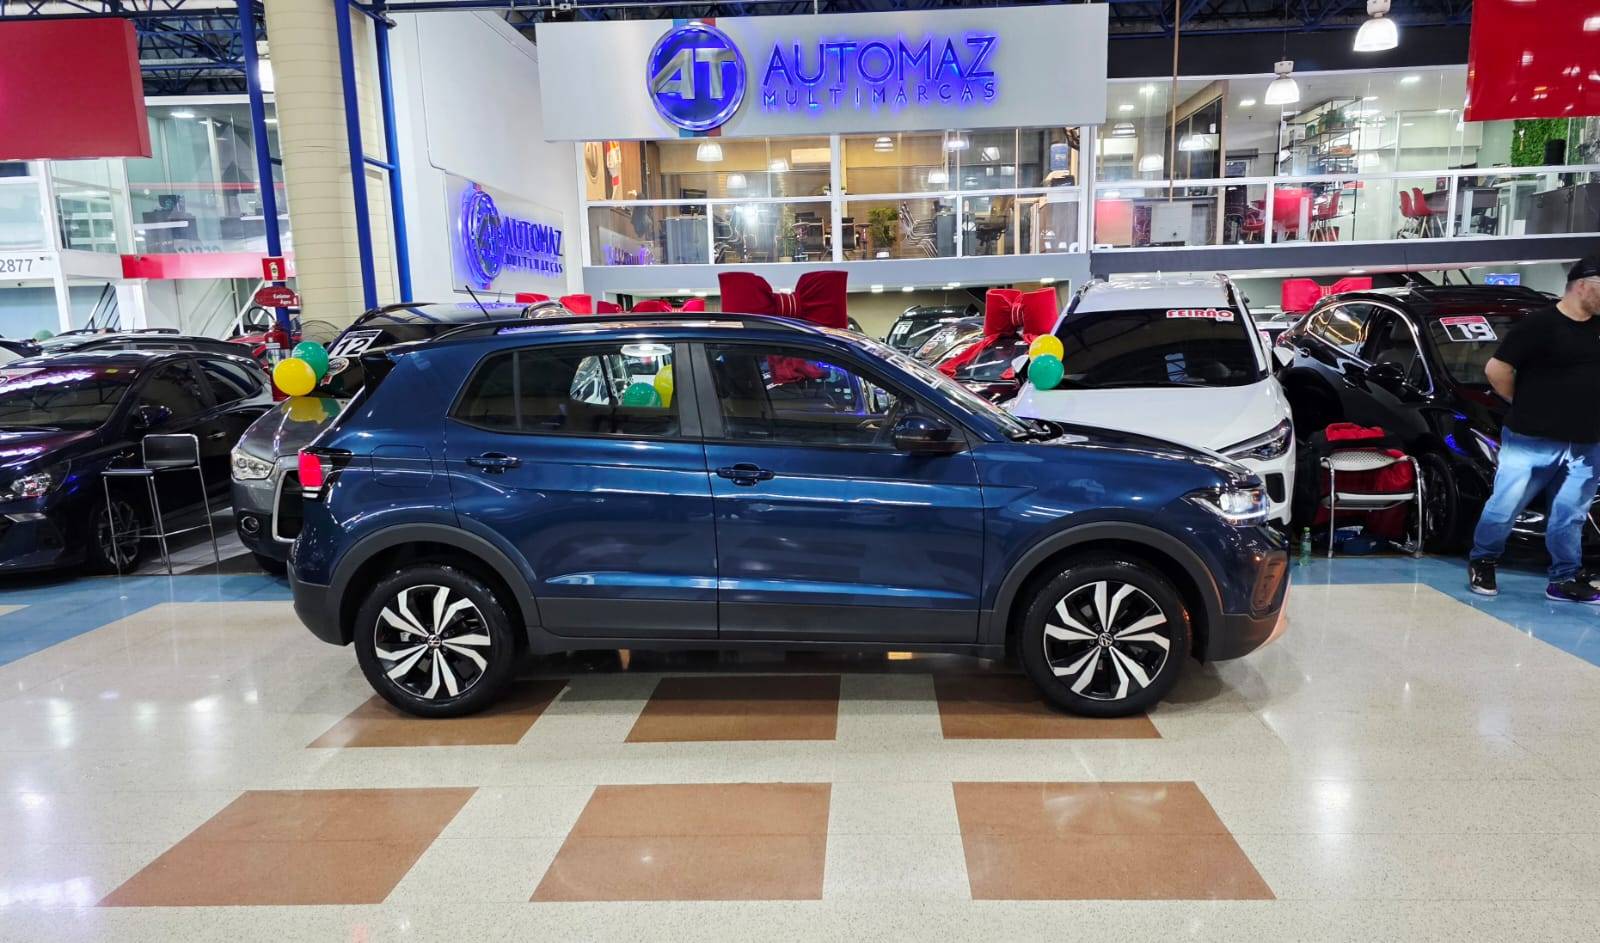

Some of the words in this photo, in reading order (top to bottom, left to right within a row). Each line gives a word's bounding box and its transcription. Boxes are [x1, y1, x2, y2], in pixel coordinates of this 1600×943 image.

[651, 47, 737, 100] AT
[763, 36, 996, 87] AUTOMAZ
[763, 82, 995, 106] MULTIMARCAS
[502, 216, 564, 257] AUTOMAZ
[0, 258, 33, 273] 2877
[1456, 323, 1494, 340] 19
[336, 338, 370, 357] 12
